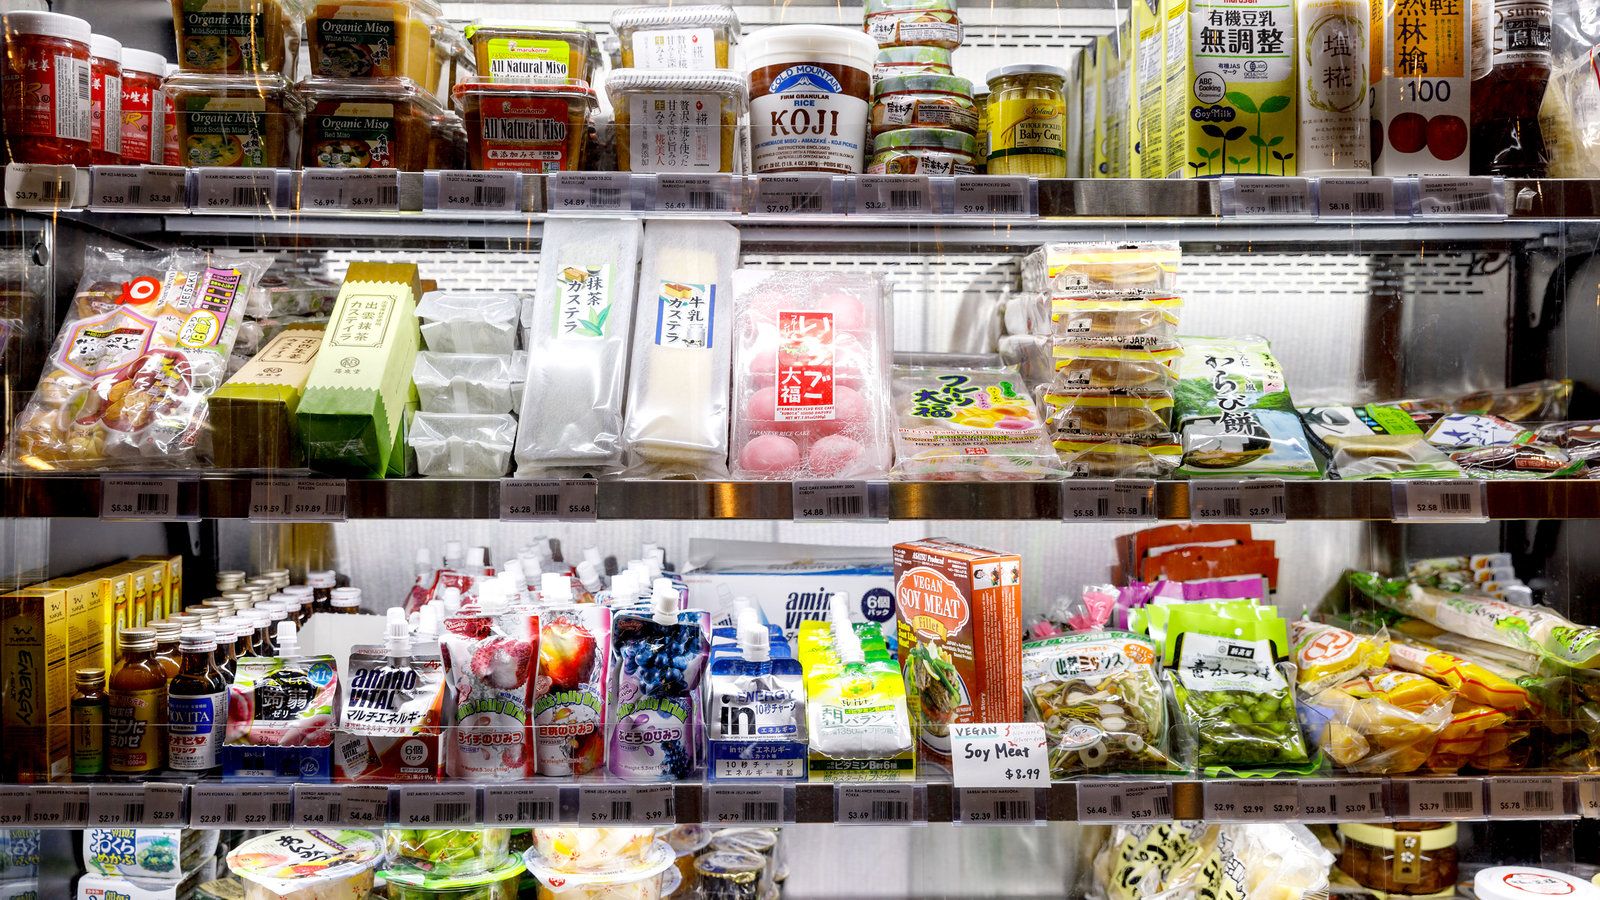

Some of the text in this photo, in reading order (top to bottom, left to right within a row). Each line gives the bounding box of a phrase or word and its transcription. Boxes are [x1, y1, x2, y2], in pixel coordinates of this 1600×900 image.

[189, 13, 259, 27] Organic Miso
[1208, 9, 1276, 27] 有機豆乳
[322, 21, 390, 35] Organic Miso
[1200, 26, 1285, 54] 無調整
[1322, 34, 1353, 89] 塩糀
[491, 60, 567, 74] All Natural Miso
[769, 65, 841, 92] COLD MOUNTAIN
[1407, 80, 1451, 102] 100
[1194, 108, 1232, 119] Soy Milk
[191, 112, 261, 126] Organic Miso
[322, 117, 389, 131] Organic Miso
[770, 108, 840, 136] KOJI
[483, 118, 566, 141] All Natural Miso
[1019, 128, 1043, 143] Baby
[16, 191, 38, 200] $3.79
[102, 195, 124, 204] $3.38
[149, 194, 171, 203] $3.38
[448, 196, 470, 204] $4.89
[208, 197, 230, 206] $6.99
[313, 199, 335, 207] $6.99
[352, 197, 374, 206] $6.99
[564, 198, 586, 207] $4.89
[665, 201, 686, 210] $6.49
[1329, 202, 1350, 211] $8.18
[766, 204, 790, 214] $7.99
[963, 205, 985, 214] $2.99
[1431, 205, 1452, 214] $7.19
[179, 271, 200, 307] MEISAKU
[586, 276, 603, 306] 抹茶
[563, 280, 582, 334] カステラ
[687, 296, 704, 322] 牛乳
[339, 300, 363, 342] カステイラ
[354, 300, 379, 342] 出雲抹茶
[665, 297, 683, 344] カステラ
[1129, 336, 1157, 346] JAPAN
[780, 366, 802, 403] 大福
[1204, 354, 1257, 435] わらび餅
[911, 389, 955, 418] 大福
[111, 503, 133, 513] $5.38
[254, 504, 280, 513] $19.59
[295, 504, 321, 513] $19.89
[509, 505, 531, 514] $6.28
[569, 504, 591, 513] $5.68
[803, 508, 824, 517] $4.88
[1116, 506, 1138, 516] $5.58
[1249, 507, 1270, 516] $2.59
[1417, 504, 1438, 513] $2.58
[1073, 509, 1094, 518] $5.58
[1200, 509, 1221, 518] $5.39
[913, 574, 943, 593] VEGAN
[866, 595, 891, 608] 6個
[901, 586, 961, 619] SOY MEAT
[918, 616, 940, 633] Fillet
[350, 667, 418, 691] amino
[15, 649, 34, 726] ENERGY
[348, 688, 396, 710] VITAL
[737, 689, 795, 703] ENERGY
[754, 703, 796, 715] 10秒チャージ
[346, 709, 430, 725] マルチエネルギー
[720, 694, 757, 735] in
[539, 722, 595, 738] 白桃のひみつ
[760, 725, 794, 734] エネルギー
[955, 726, 998, 737] VEGAN
[458, 732, 523, 747] ライチのひみつ
[404, 744, 424, 755] 6個
[964, 742, 1030, 762] Soy Meat
[725, 760, 795, 769] 10秒チャージ
[1004, 767, 1041, 780] $8.99
[1086, 806, 1108, 816] $6.48
[1214, 803, 1235, 812] $2.99
[1243, 805, 1264, 814] $2.99
[1273, 804, 1294, 813] $2.99
[1305, 806, 1327, 815] $2.88
[1345, 804, 1366, 813] $3.09
[1419, 802, 1440, 812] $3.79
[1500, 802, 1521, 811] $5.78
[33, 812, 60, 822] $10.99
[99, 814, 120, 823] $2.19
[153, 811, 175, 820] $2.59
[245, 814, 267, 823] $2.29
[303, 814, 324, 823] $4.48
[349, 811, 373, 821] $4.48
[409, 814, 431, 823] $4.48
[498, 813, 514, 823] $.99
[646, 810, 662, 820] $.99
[718, 813, 739, 823] $4.79
[848, 811, 869, 820] $3.69
[970, 812, 991, 821] $2.39
[1131, 809, 1152, 819] $5.39
[0, 815, 22, 824] $3.99
[200, 815, 221, 824] $2.89
[97, 853, 136, 865] めかぶ
